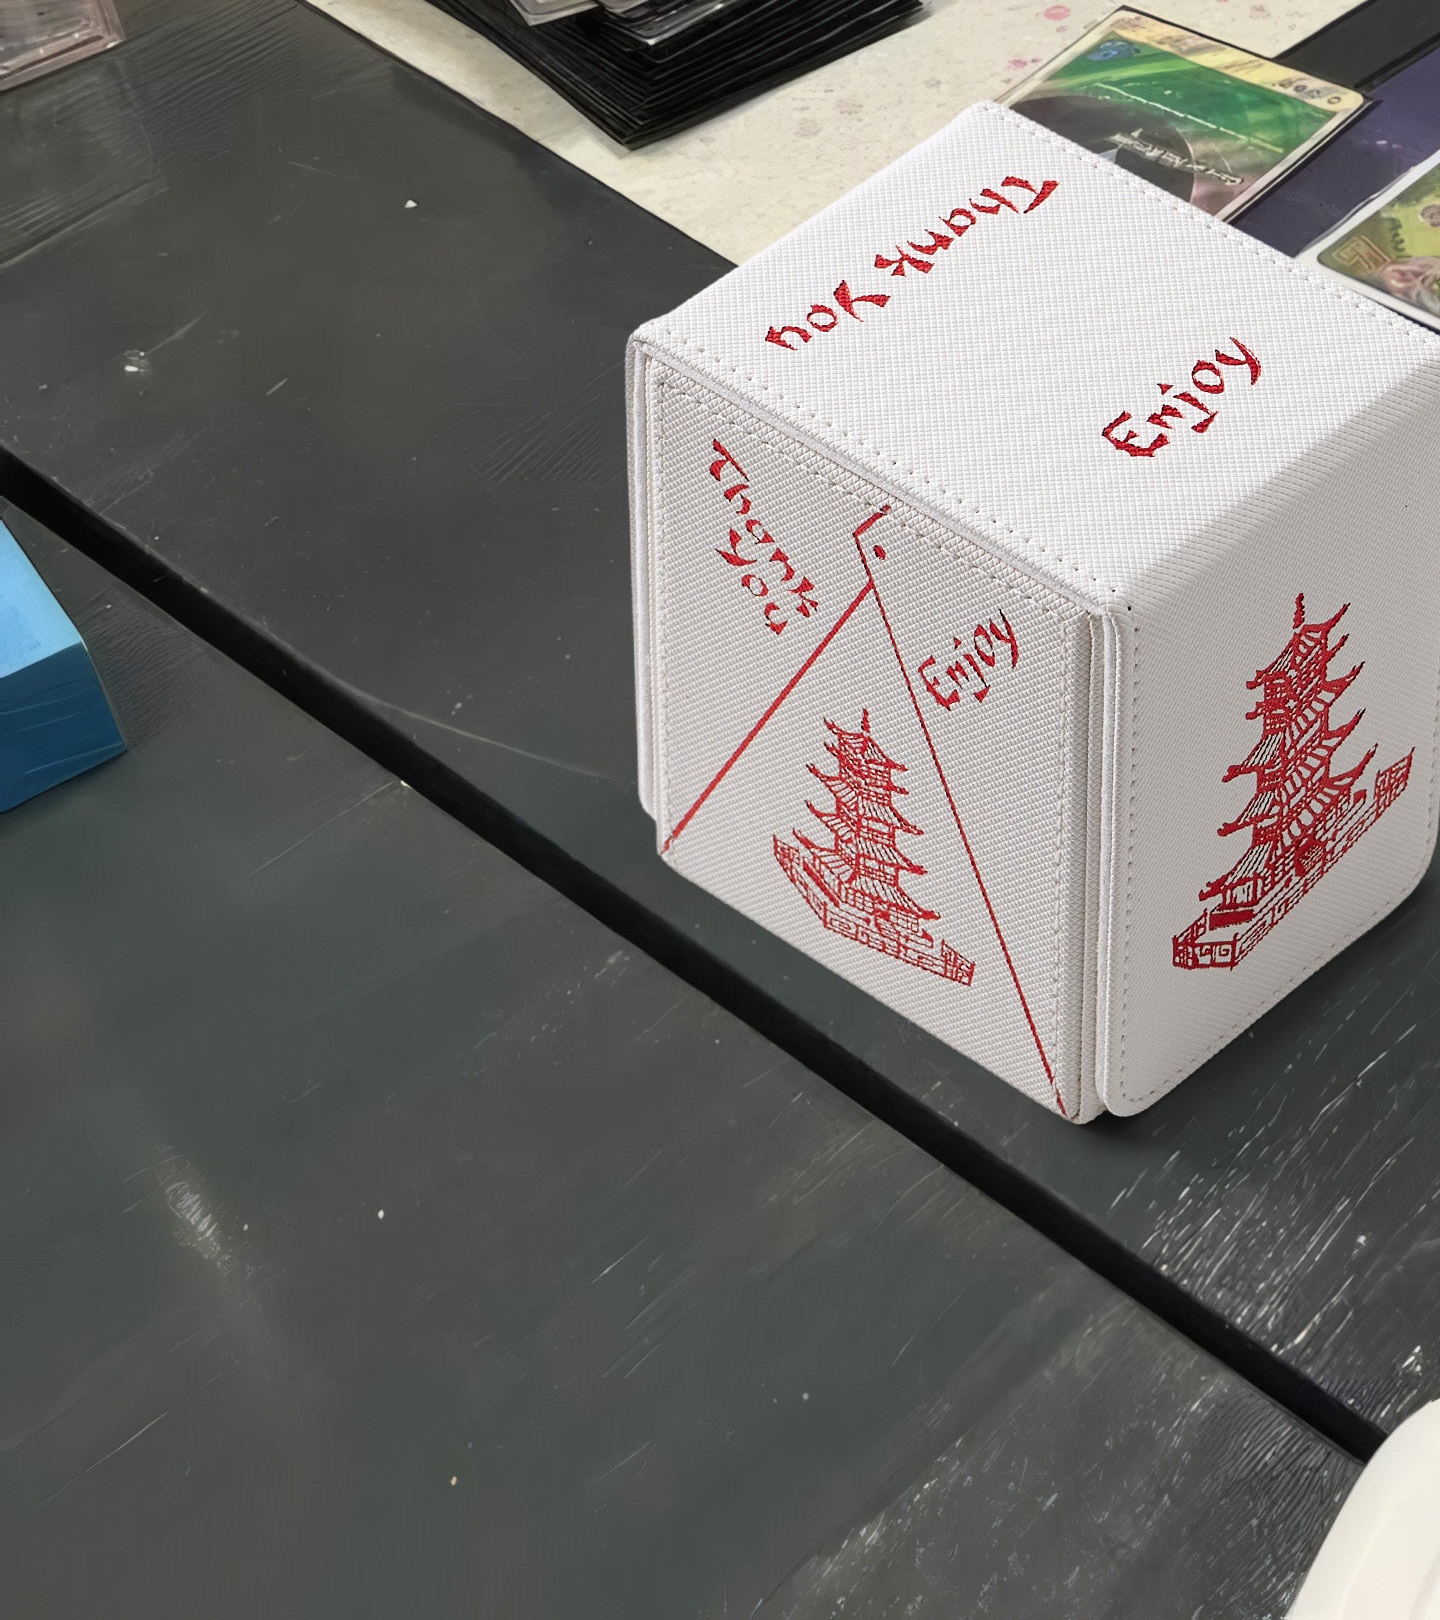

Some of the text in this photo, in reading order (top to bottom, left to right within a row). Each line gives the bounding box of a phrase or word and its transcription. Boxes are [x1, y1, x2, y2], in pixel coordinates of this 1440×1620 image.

[766, 176, 1058, 350] Thank You
[1104, 337, 1262, 458] Enjoy
[709, 438, 819, 618] Thank
[715, 527, 788, 635] You
[917, 608, 1019, 711] Enjoy
